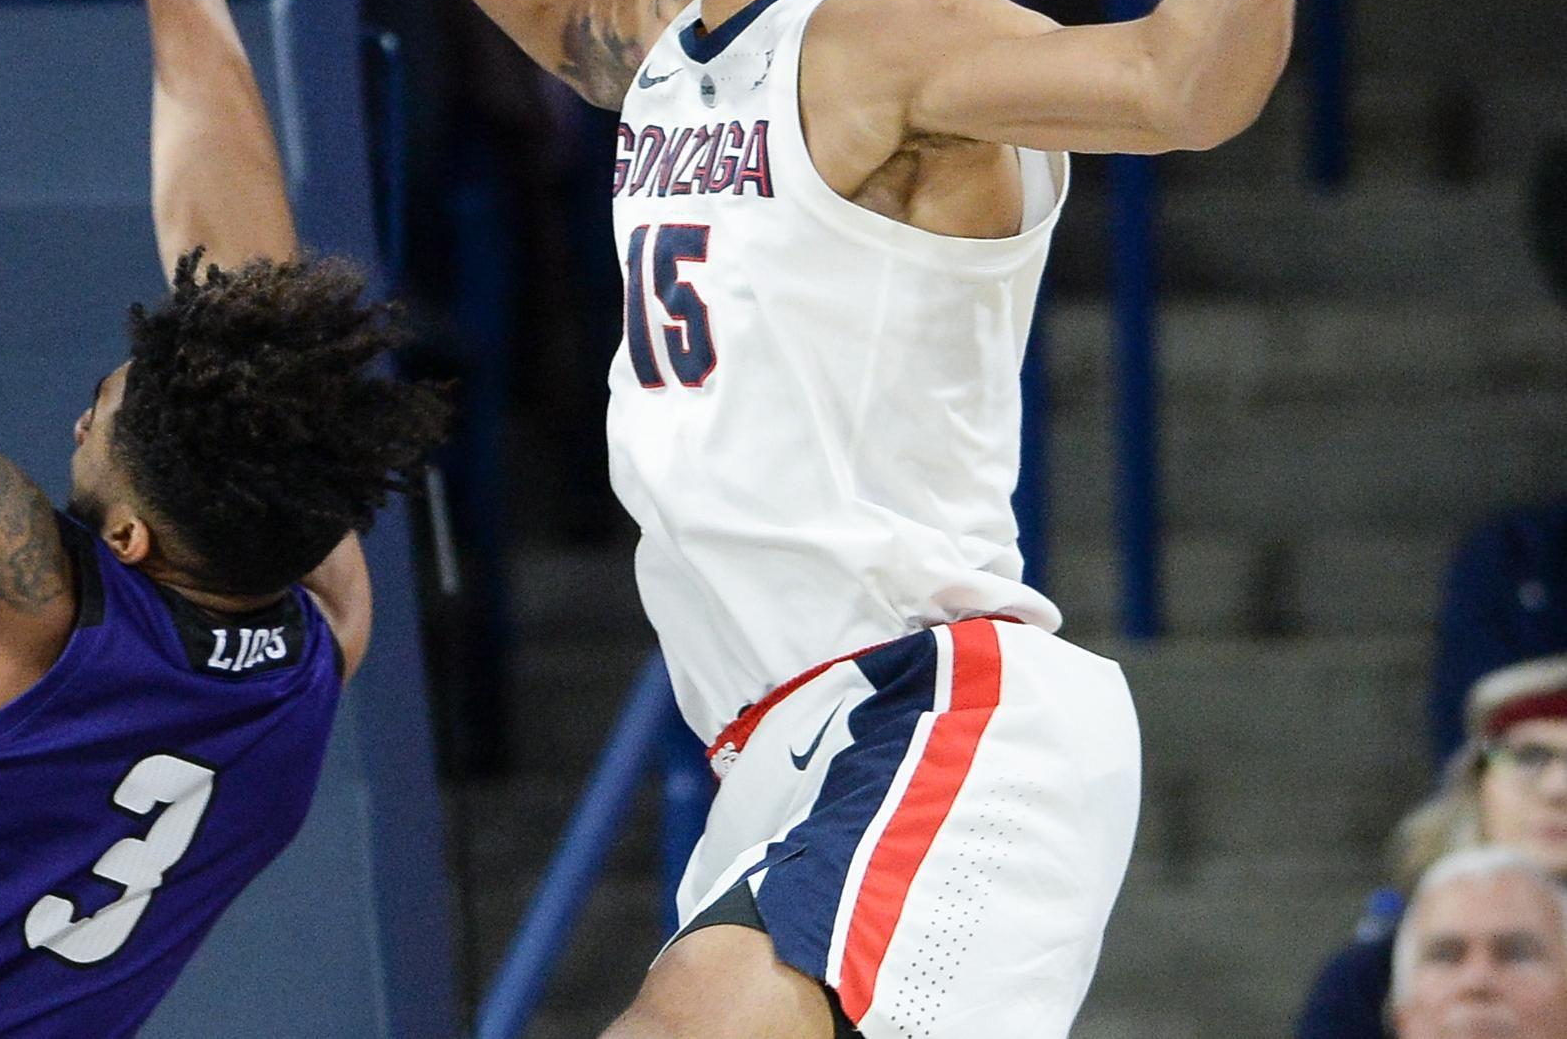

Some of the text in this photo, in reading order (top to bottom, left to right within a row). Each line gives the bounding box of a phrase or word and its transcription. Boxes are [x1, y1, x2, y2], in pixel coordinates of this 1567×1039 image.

[612, 119, 775, 198] GONZAGA
[624, 223, 718, 388] 15
[24, 754, 216, 963] 3
